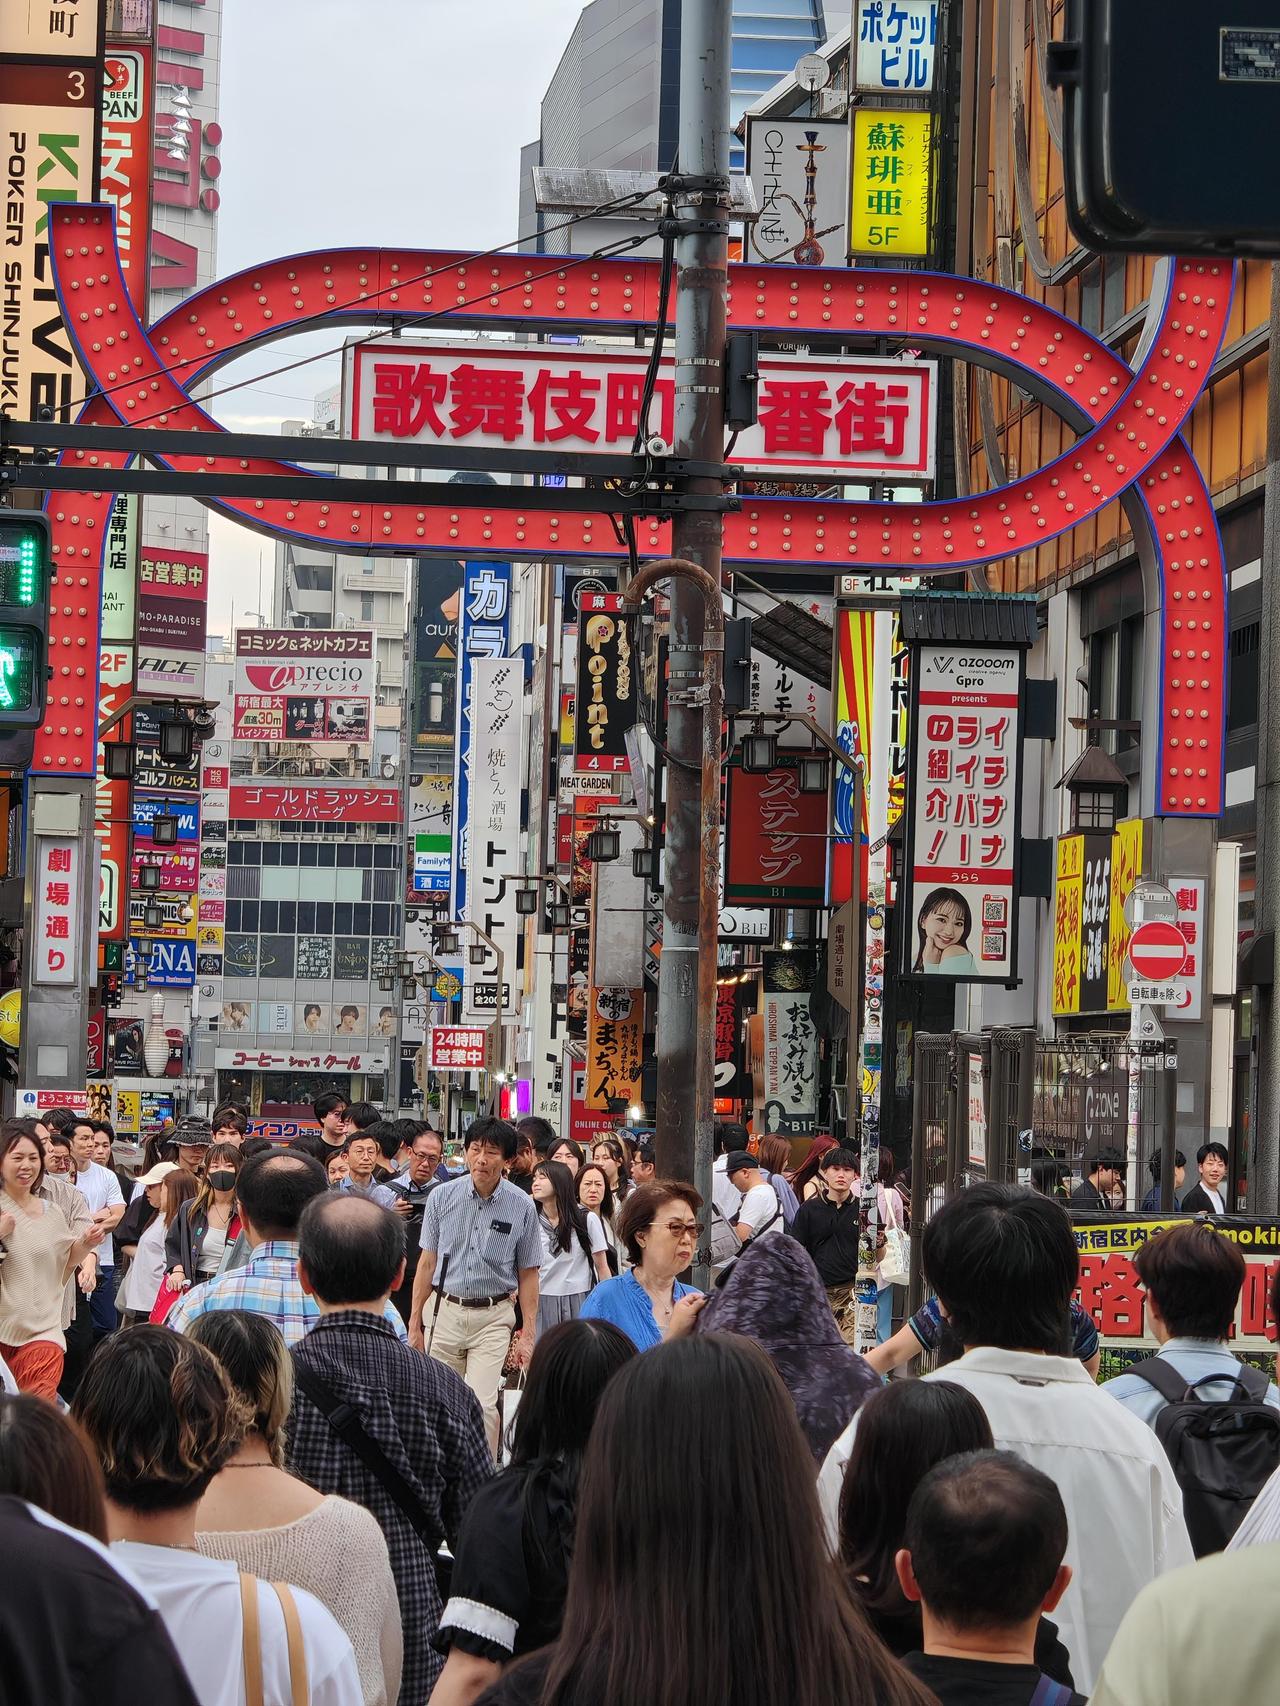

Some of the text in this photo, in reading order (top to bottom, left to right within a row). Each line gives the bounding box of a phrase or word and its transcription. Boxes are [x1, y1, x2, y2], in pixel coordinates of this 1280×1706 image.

[881, 47, 928, 89] ビル
[66, 71, 85, 100] 3
[110, 91, 133, 99] BEEF
[5, 131, 26, 247] POKER
[867, 226, 899, 246] 5F
[372, 362, 910, 457] 歌舞伎町番街
[582, 568, 600, 576] 6F
[844, 579, 859, 590] 3F
[239, 634, 370, 653] コミック&ネットカフェ
[100, 654, 128, 671] 2F
[138, 656, 201, 676] ACE
[958, 658, 1014, 669] azooom
[269, 660, 362, 690] aprecio
[956, 675, 984, 688] Gpro
[238, 696, 284, 709] 新宿最大
[951, 695, 988, 704] presents
[139, 770, 198, 788] ゴルフ バグース
[560, 776, 611, 790] MEAT GARDEN
[245, 788, 395, 806] ゴールドラッシュ
[487, 748, 507, 832] 焼とん酒場
[954, 716, 981, 865] ライバー
[980, 716, 1009, 866] イチナナ
[275, 806, 345, 819] ハンバーグ
[760, 772, 801, 883] ステップ
[870, 836, 887, 855] WEED
[420, 877, 432, 889] 酒
[951, 872, 979, 883] うらら
[46, 848, 72, 972] 劇場通り
[740, 922, 768, 935] B1F
[834, 924, 846, 988] 劇場通り一番街
[1131, 986, 1182, 1001] 自転車を除く
[436, 1031, 483, 1048] 24時間
[766, 1002, 777, 1095] HIROSHIMA TEPPANYAKI
[232, 1052, 361, 1070] コーヒー ショップ クール
[436, 1049, 482, 1065] 営業中
[594, 1022, 619, 1099] まっちゃん
[782, 1001, 815, 1104] お好み焼き
[575, 1120, 600, 1129] ONLINE
[791, 1119, 815, 1133] B1F
[1075, 1225, 1167, 1249] 新宿区内
